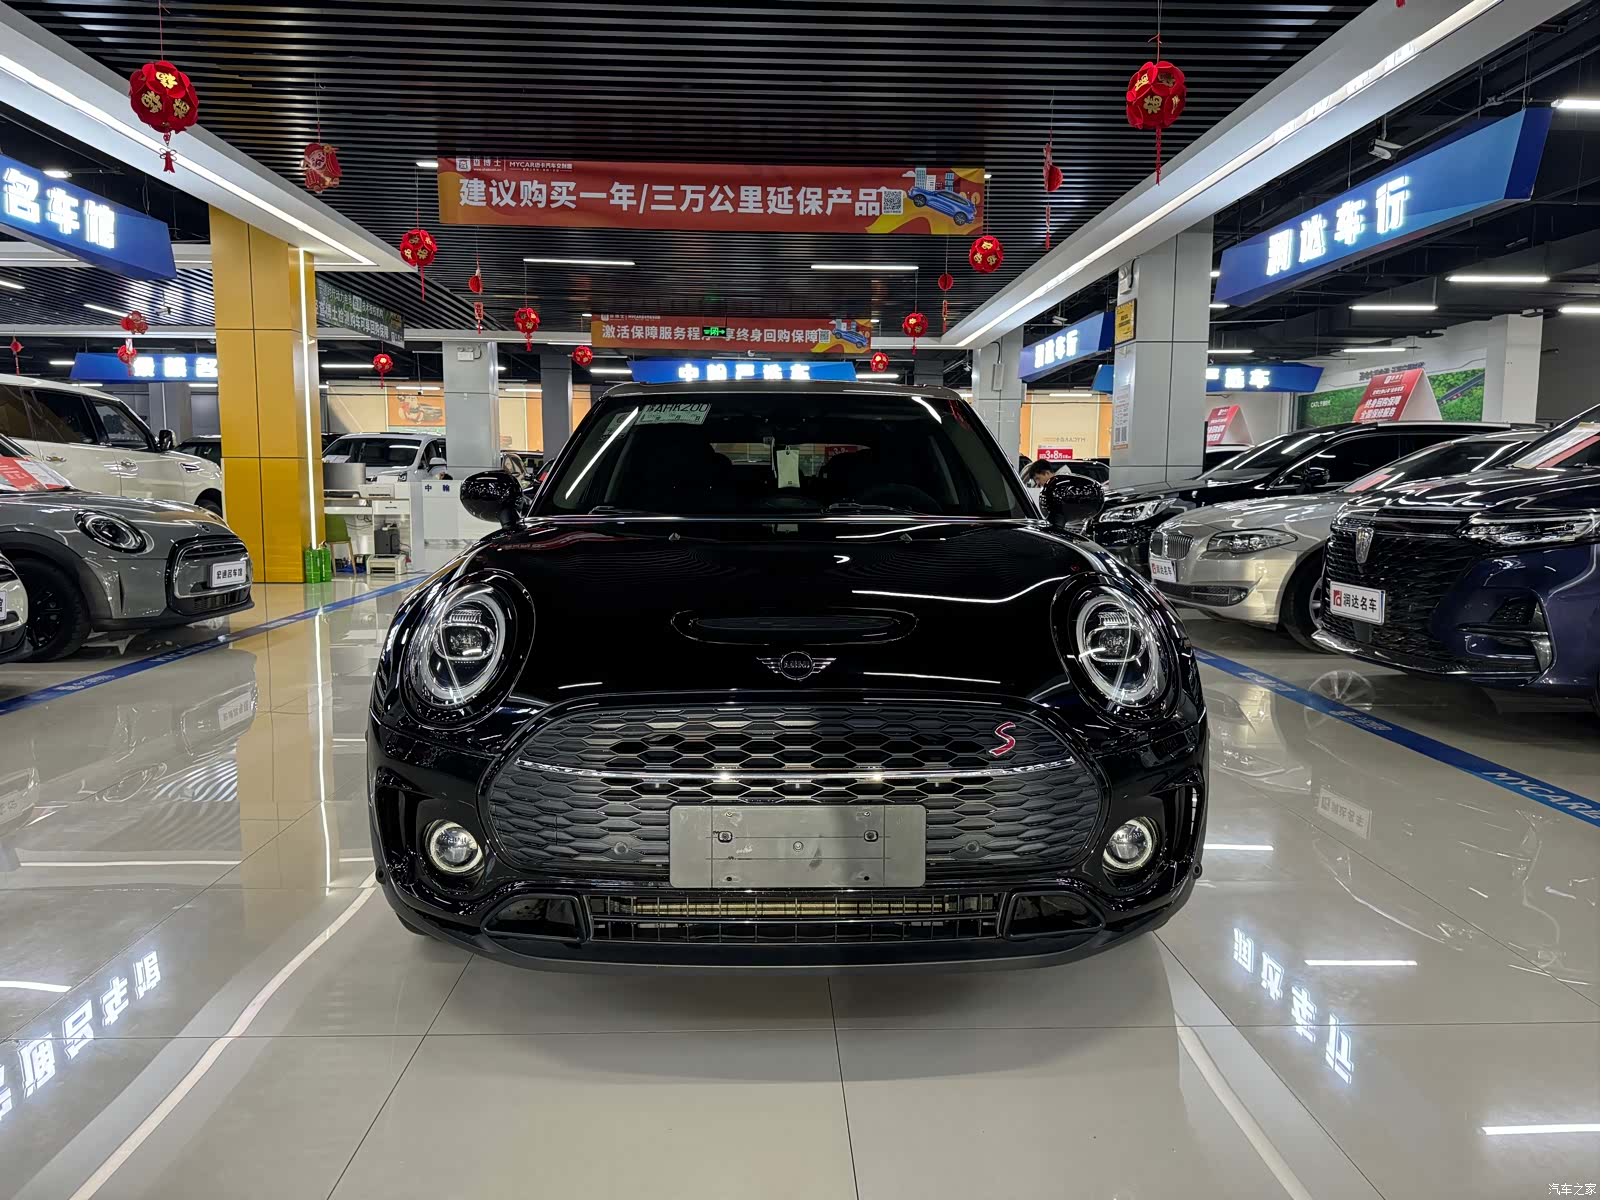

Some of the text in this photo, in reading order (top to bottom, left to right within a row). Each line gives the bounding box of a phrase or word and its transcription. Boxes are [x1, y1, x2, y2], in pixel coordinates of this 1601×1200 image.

[3, 167, 115, 249] 名车馆
[459, 178, 883, 217] 建议购买一年/三万公里延保产品
[1265, 175, 1411, 277] 润达车行
[1343, 593, 1377, 613] 润达名车
[989, 721, 1016, 757] S
